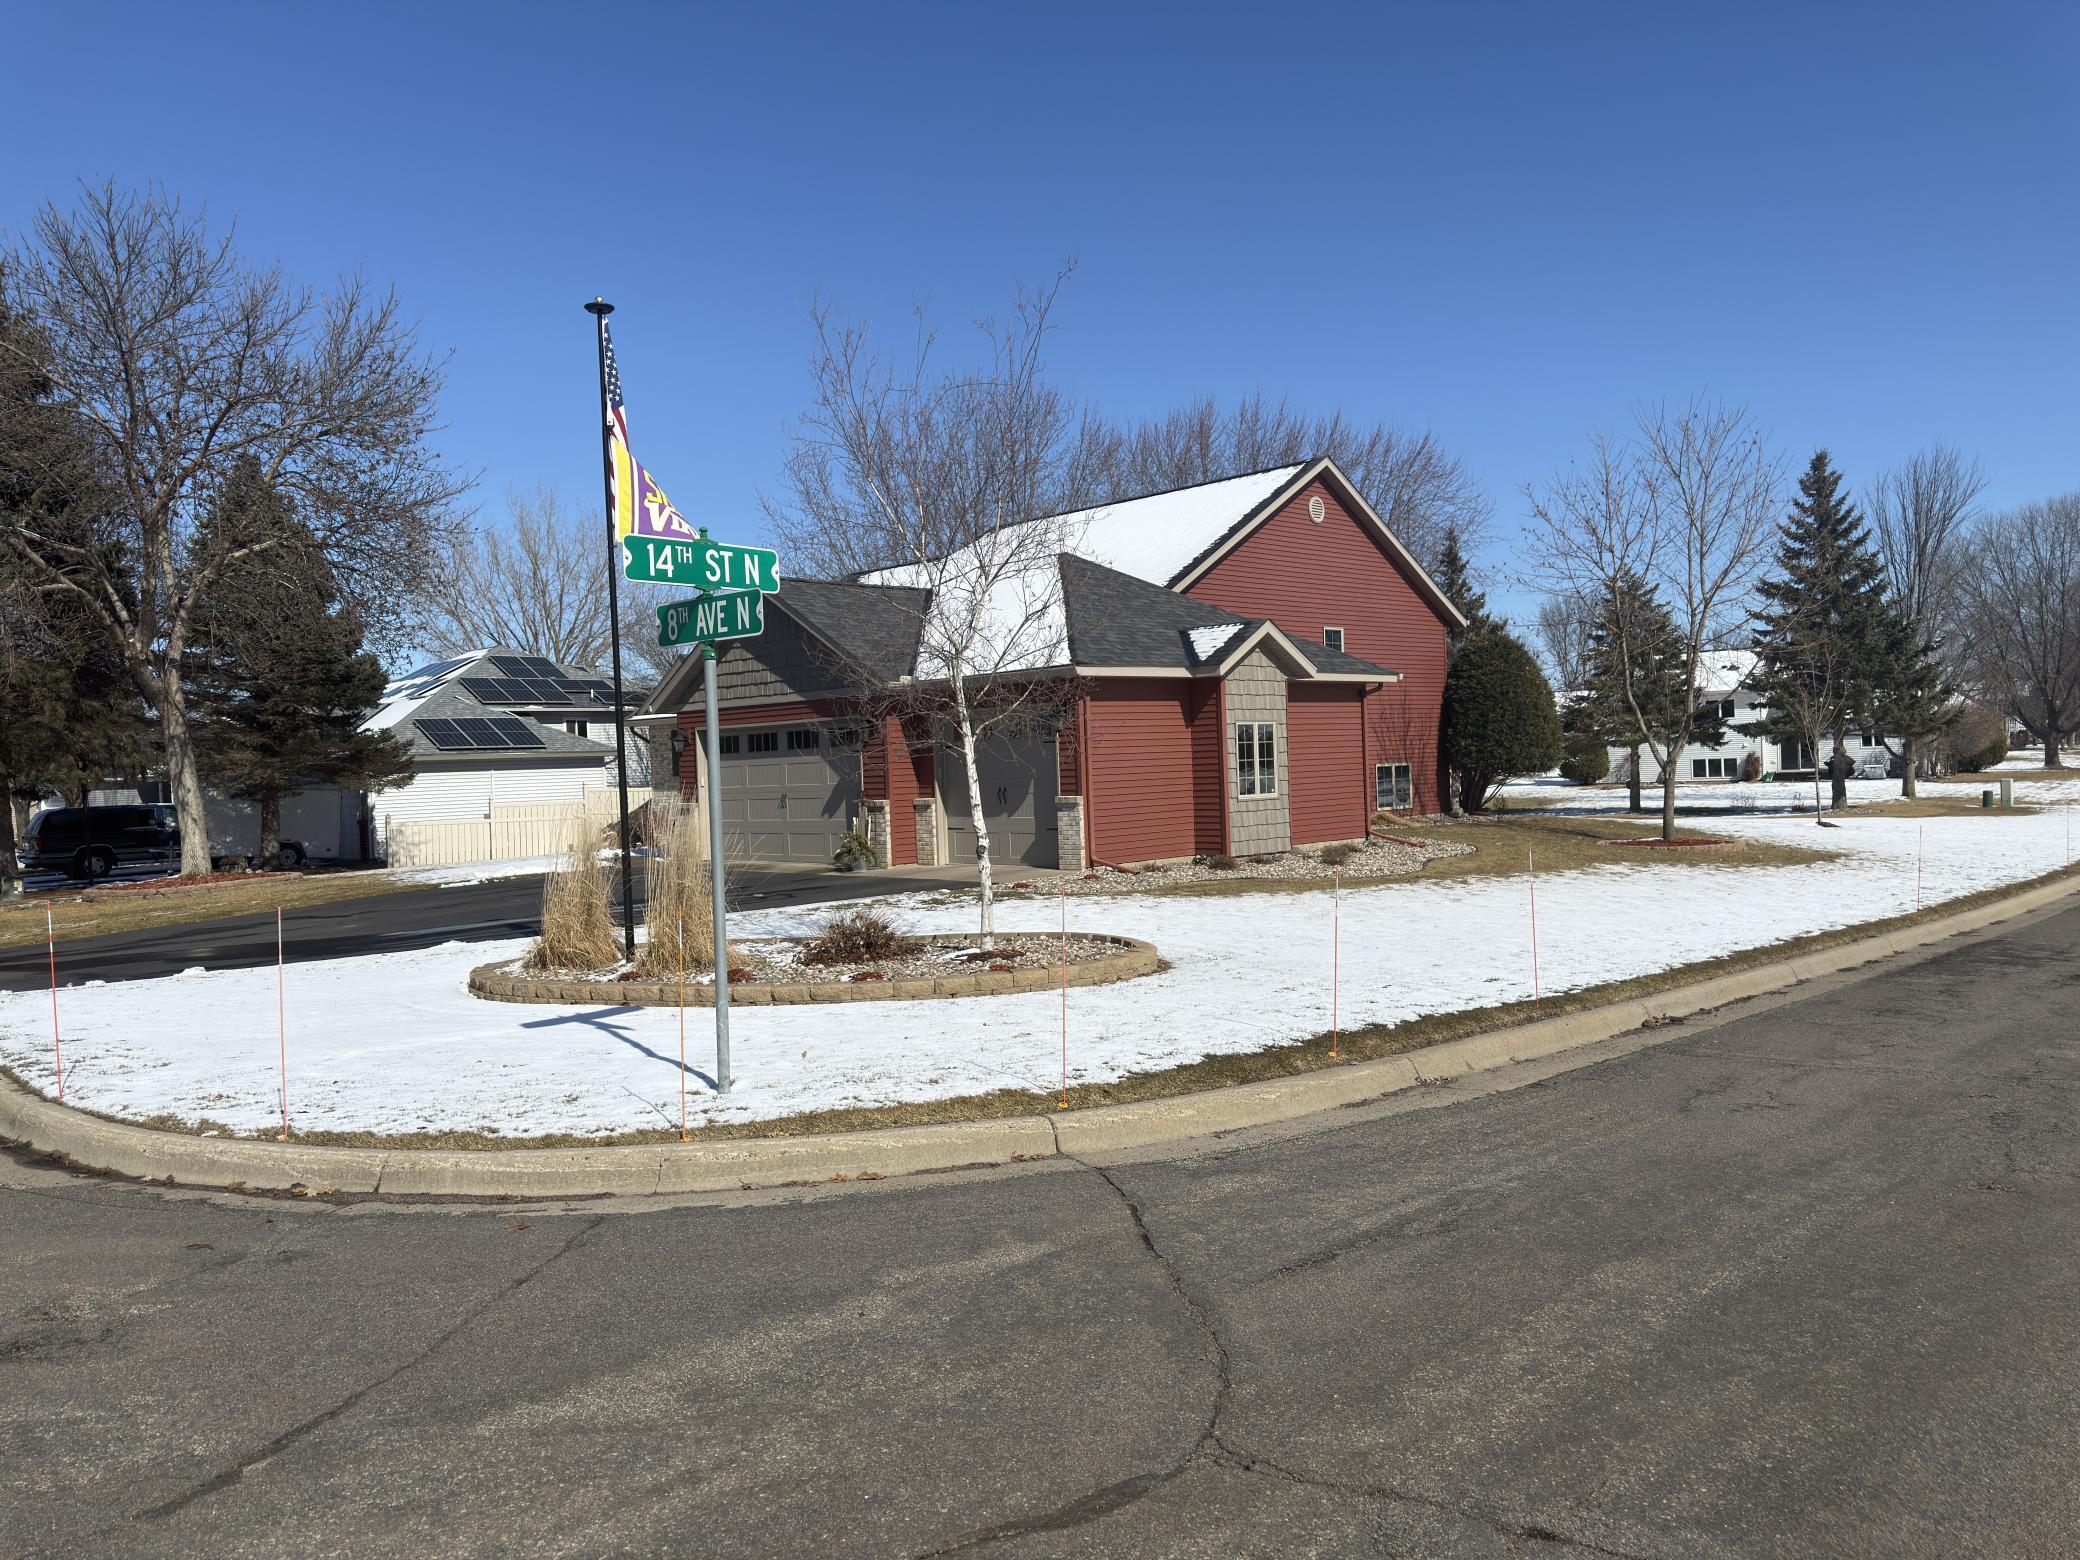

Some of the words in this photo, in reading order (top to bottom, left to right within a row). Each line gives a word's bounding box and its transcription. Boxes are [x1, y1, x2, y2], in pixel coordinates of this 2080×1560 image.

[646, 543, 693, 578] 14TH
[705, 549, 734, 583] ST
[744, 553, 760, 586] N
[667, 606, 689, 641] 8TH
[696, 600, 729, 637] AVE
[736, 596, 750, 631] N
